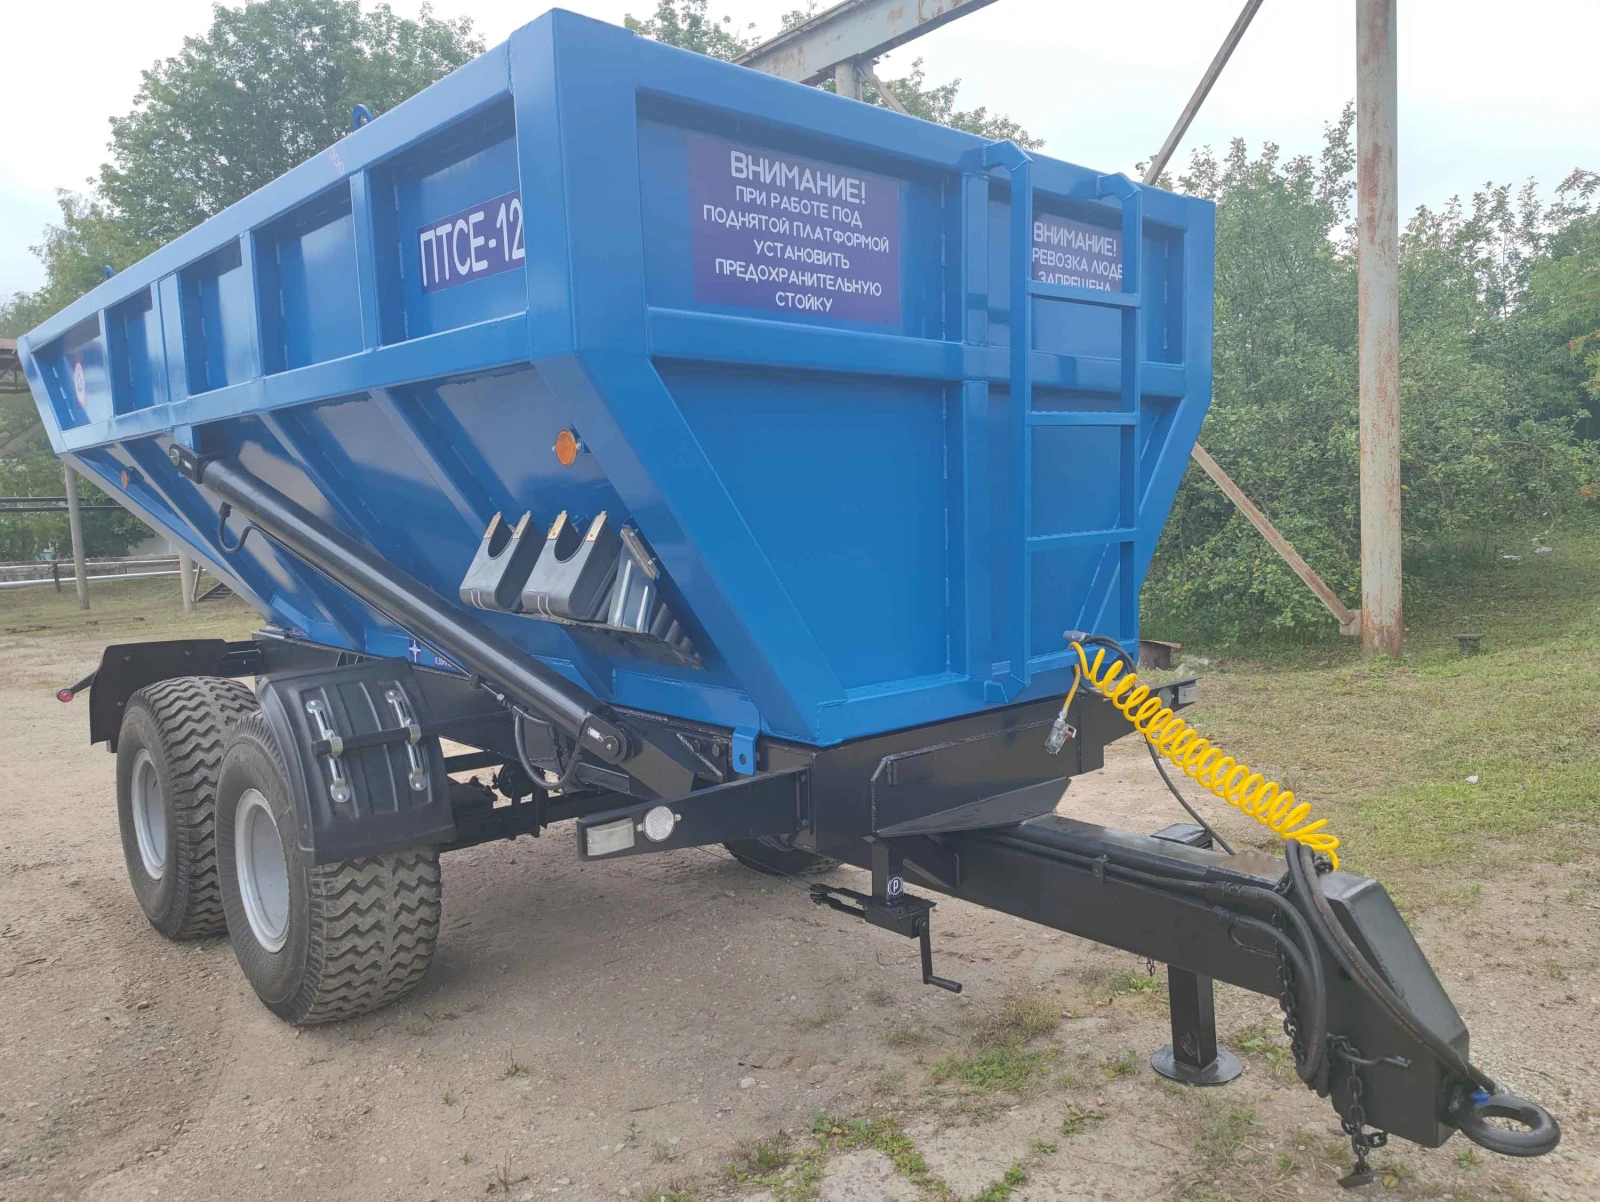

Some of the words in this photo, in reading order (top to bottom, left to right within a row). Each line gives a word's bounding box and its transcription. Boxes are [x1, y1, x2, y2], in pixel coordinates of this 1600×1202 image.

[731, 150, 866, 205] ВНИМАНИЕ!
[736, 185, 767, 207] ПРИ
[771, 192, 829, 219] РАБОТЕ
[833, 206, 863, 229] ПОД
[420, 198, 525, 287] ПТСЕ-12
[703, 204, 789, 235] ПОДНЯТОЙ
[793, 222, 889, 253] ПЛАТФОРМОЙ
[1033, 221, 1117, 257] ВНИМАНИЕ!
[753, 239, 850, 269] УСТАНОВИТЬ
[1032, 247, 1088, 272] РЕВОЗКА
[1091, 259, 1123, 281] ЛЮДЕ
[715, 258, 882, 297] ПРЕДОХРАНИТЕЛЬНУЮ
[775, 291, 833, 312] СТОЙКУ
